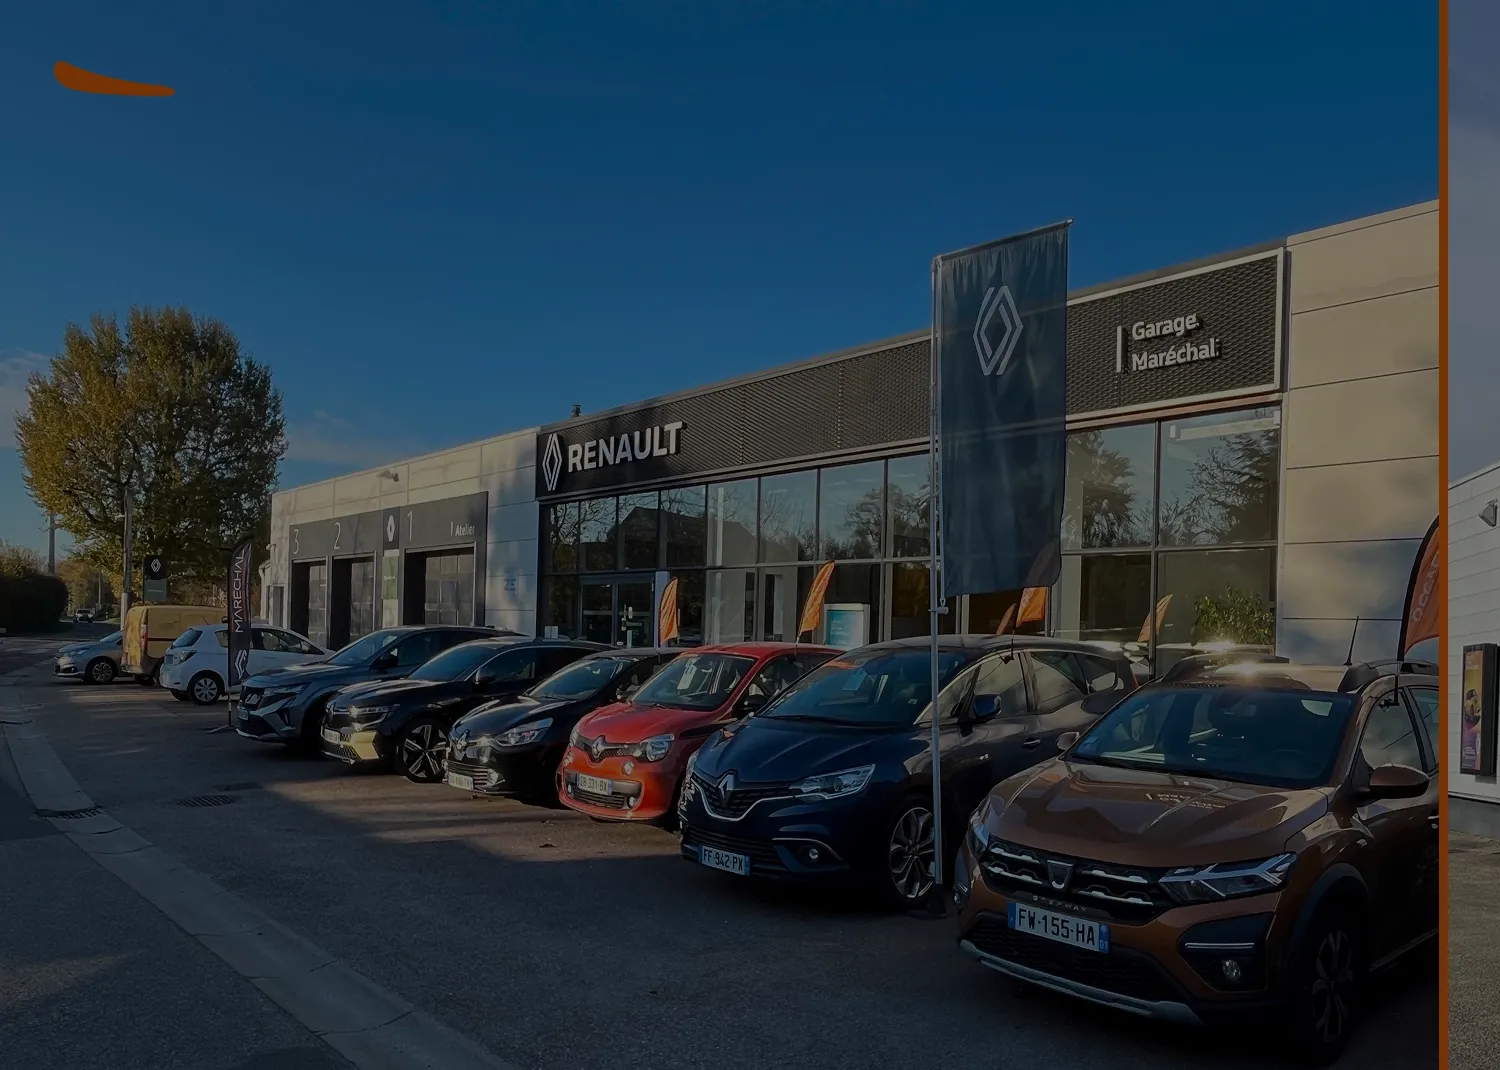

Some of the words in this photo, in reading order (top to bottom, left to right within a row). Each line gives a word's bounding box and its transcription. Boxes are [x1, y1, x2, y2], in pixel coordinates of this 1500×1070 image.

[1132, 313, 1199, 340] Garage
[1132, 337, 1217, 371] Maréchal
[568, 421, 683, 473] RENAULT
[333, 521, 341, 550] 2
[406, 510, 413, 542] 1
[454, 524, 475, 537] Atelier
[292, 528, 300, 555] 3
[233, 550, 245, 633] MARECHAL
[703, 848, 743, 872] FF-942-PX
[1018, 908, 1095, 946] FW-155-HA
